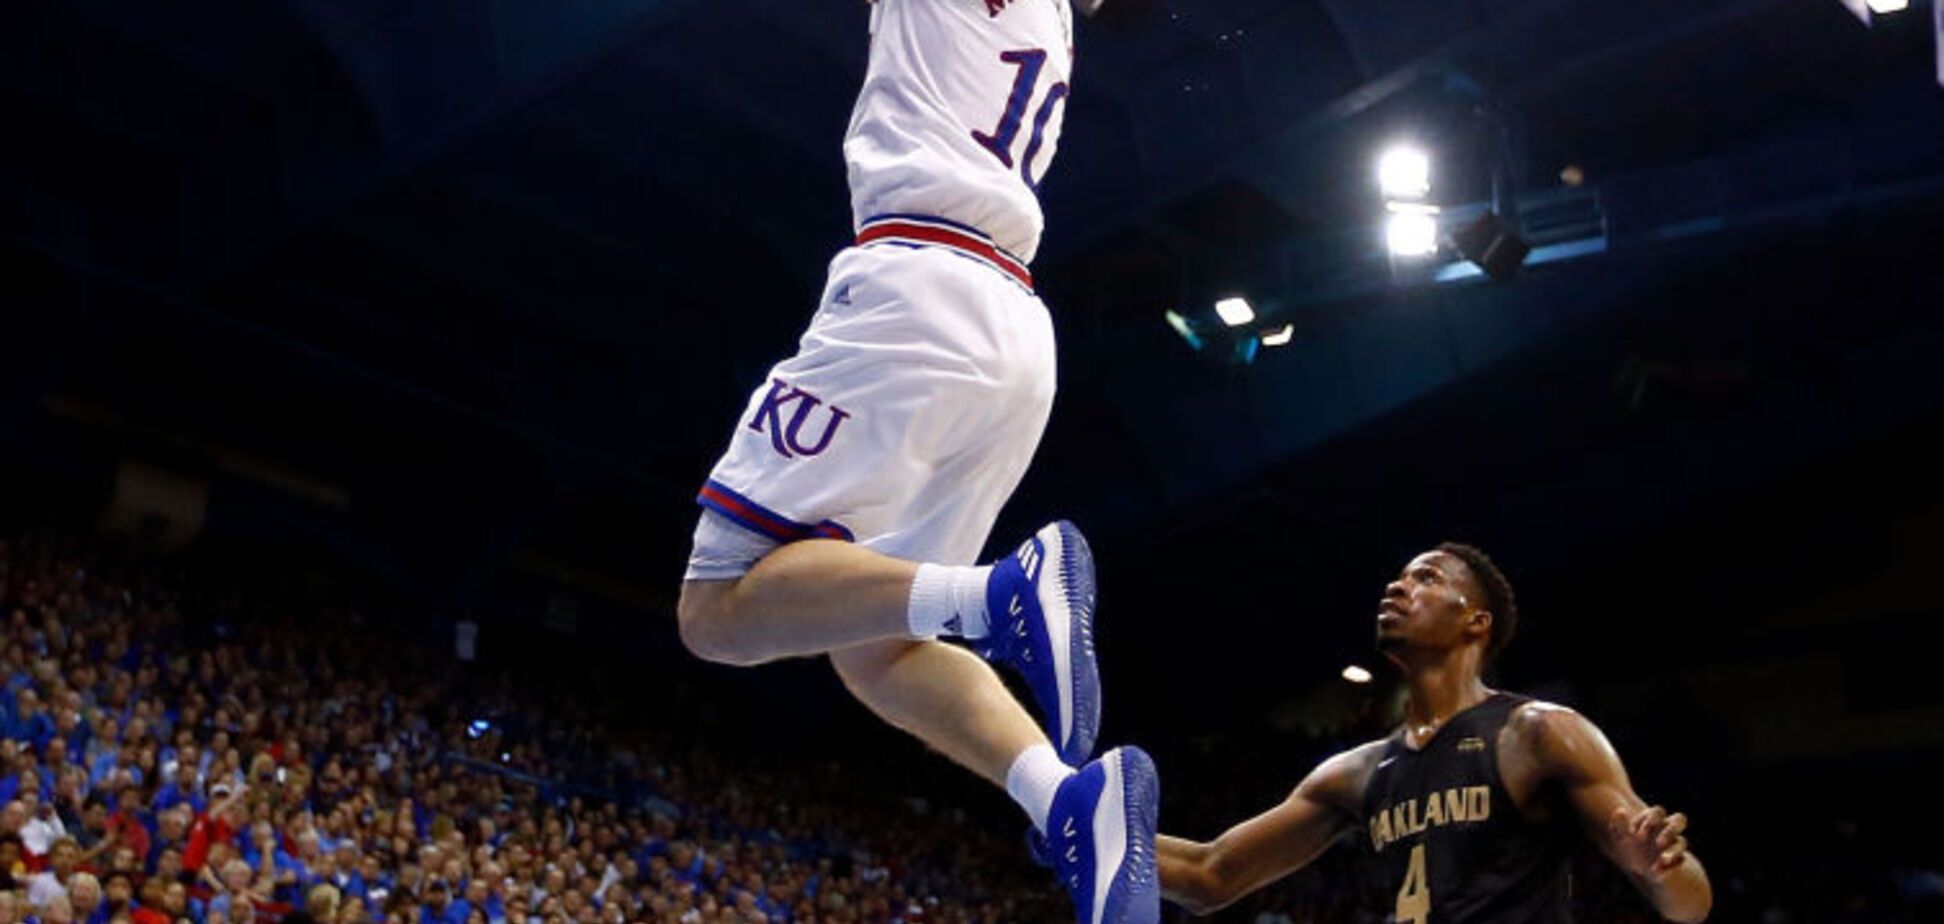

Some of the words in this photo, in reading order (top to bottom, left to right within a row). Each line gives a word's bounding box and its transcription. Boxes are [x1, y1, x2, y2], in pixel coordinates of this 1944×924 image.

[971, 49, 1068, 196] 10
[748, 377, 851, 459] KU
[1396, 843, 1431, 924] 4
